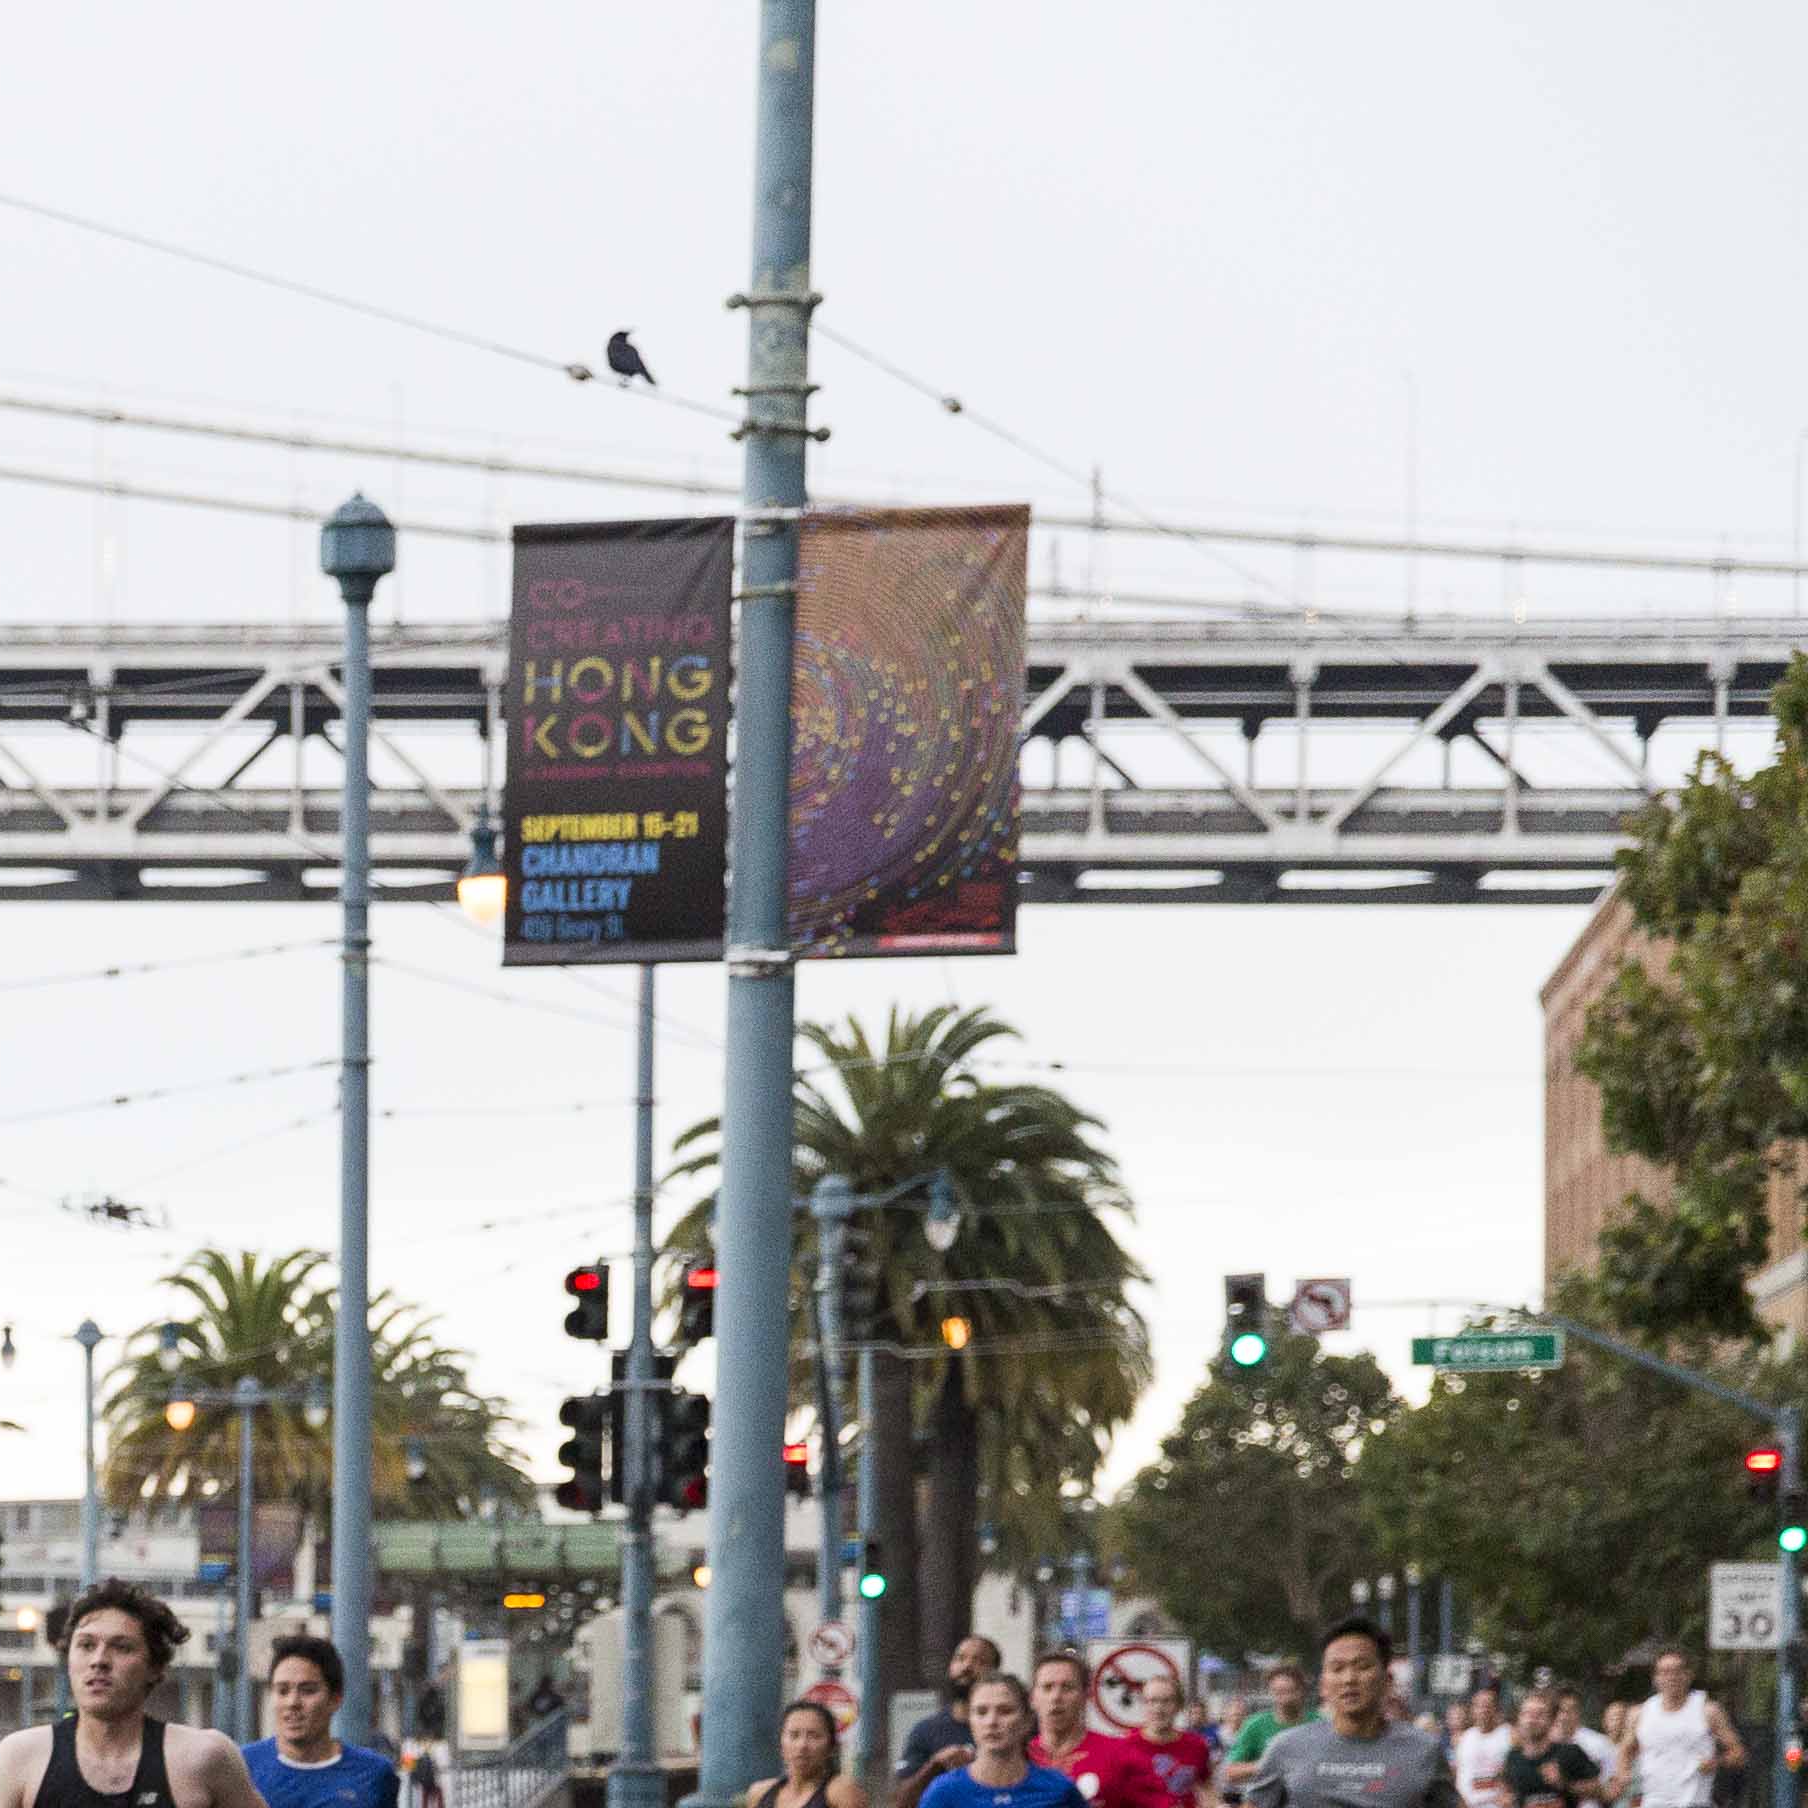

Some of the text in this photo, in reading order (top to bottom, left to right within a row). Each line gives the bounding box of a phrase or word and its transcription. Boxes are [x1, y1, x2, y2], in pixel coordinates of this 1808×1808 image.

[523, 655, 714, 705] HONG
[522, 708, 712, 758] KONG
[520, 813, 639, 843] SEPTEMBER
[521, 842, 661, 877] CHANDRAN
[521, 879, 632, 914] GALLERY
[1721, 1608, 1774, 1640] 30
